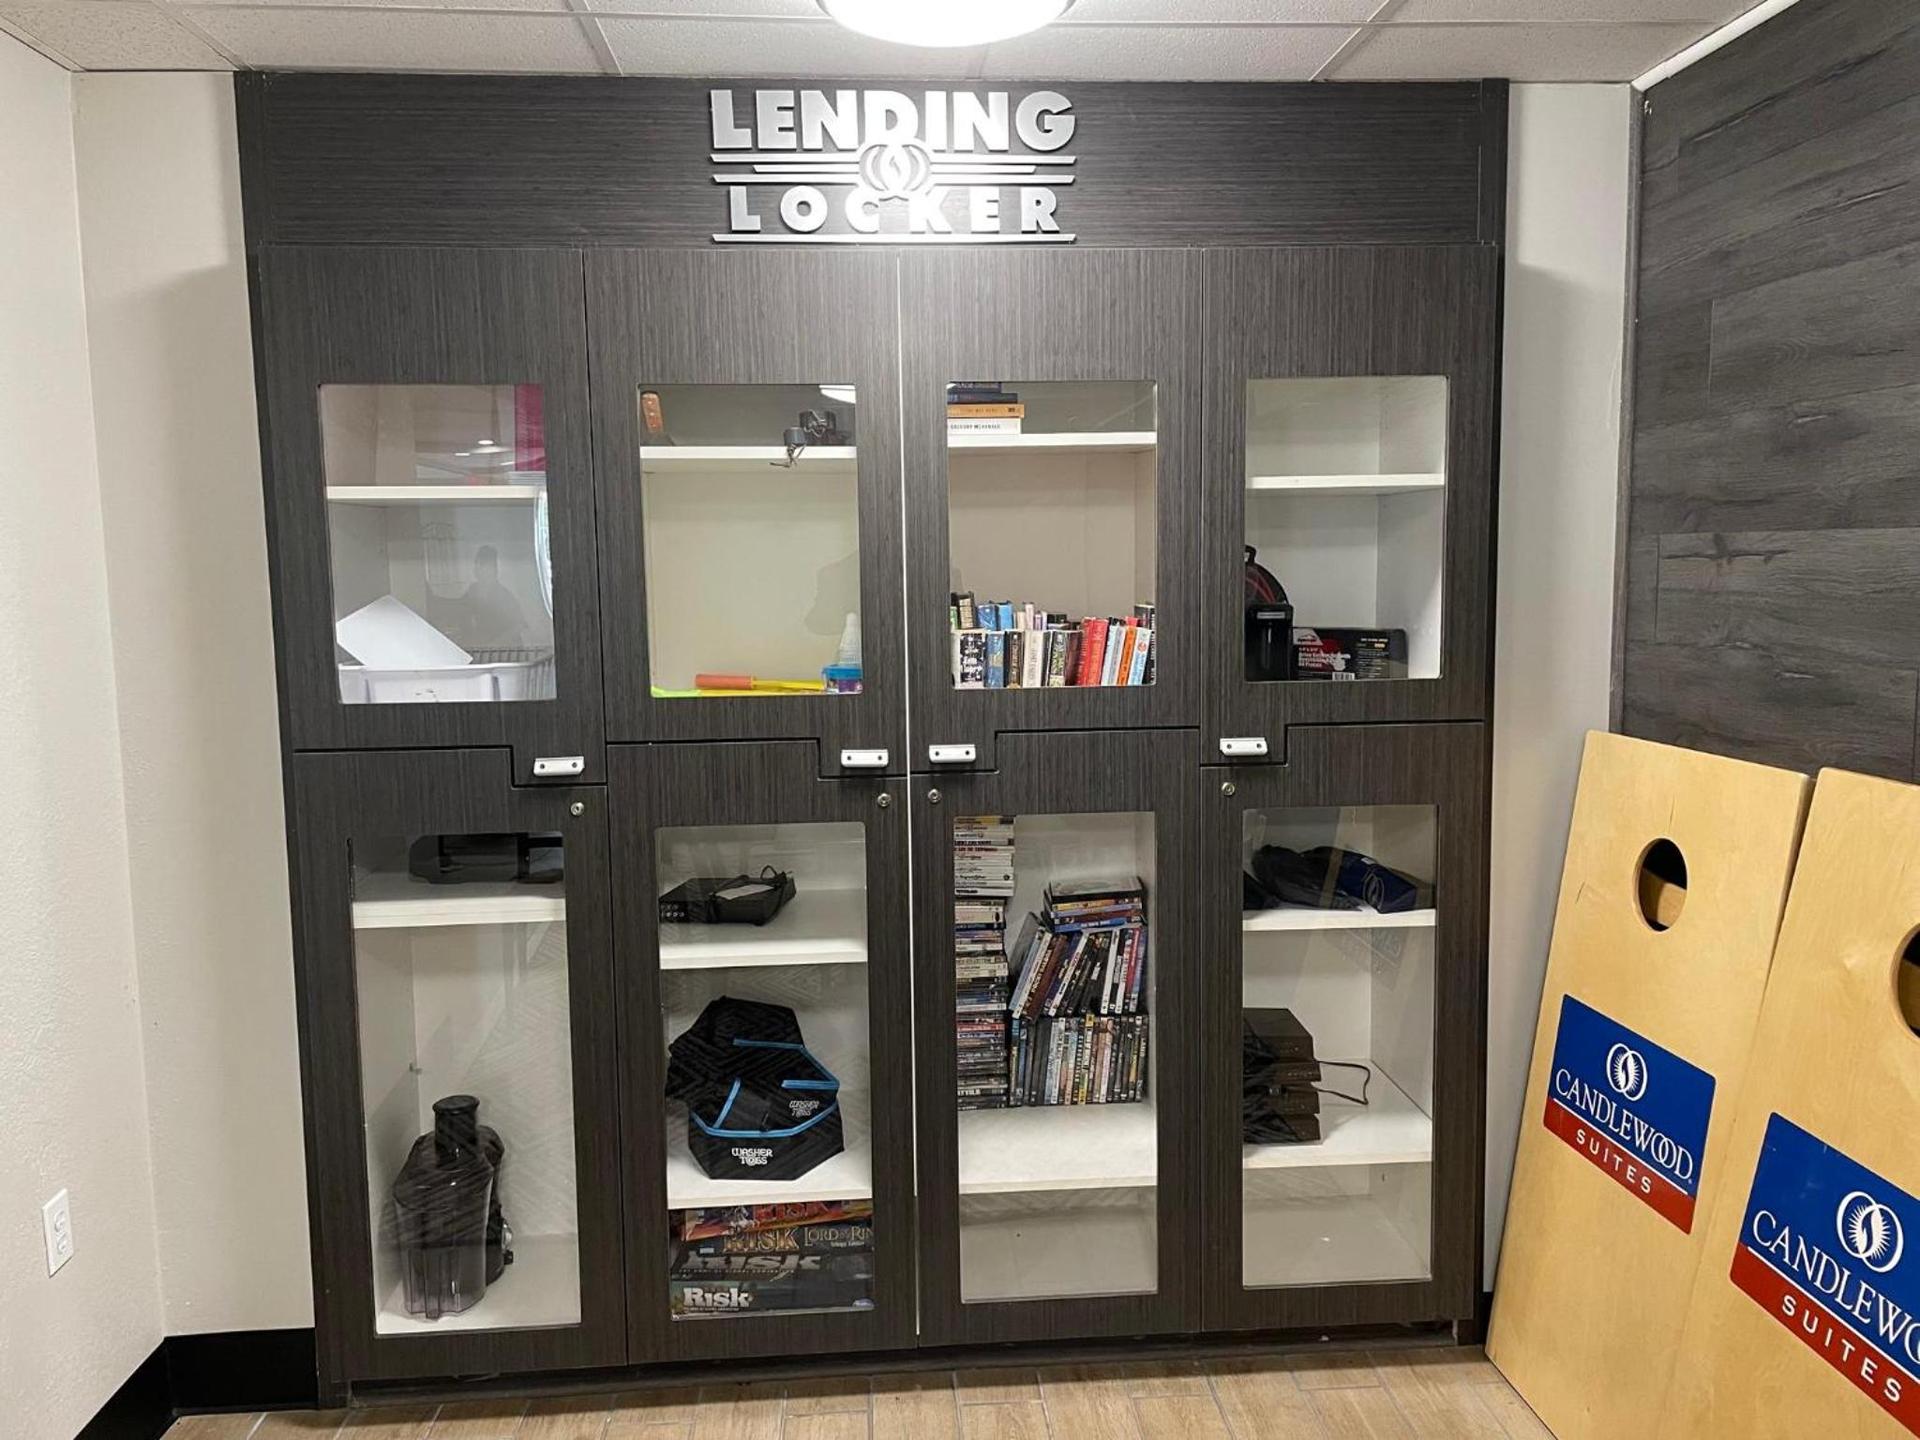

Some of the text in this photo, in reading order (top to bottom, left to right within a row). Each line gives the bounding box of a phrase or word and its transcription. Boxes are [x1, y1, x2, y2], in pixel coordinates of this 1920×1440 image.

[710, 89, 1076, 152] LENDING
[729, 185, 1060, 234] LOCKER
[1555, 1068, 1693, 1181] CANDLEWOOD
[731, 1148, 773, 1157] WASHER
[739, 1156, 768, 1166] TOSS
[1576, 1128, 1652, 1194] SUITES
[723, 1226, 800, 1253] RISK
[804, 1227, 840, 1246] LORD
[683, 1287, 750, 1308] Risk
[1782, 1295, 1901, 1402] SUITES
